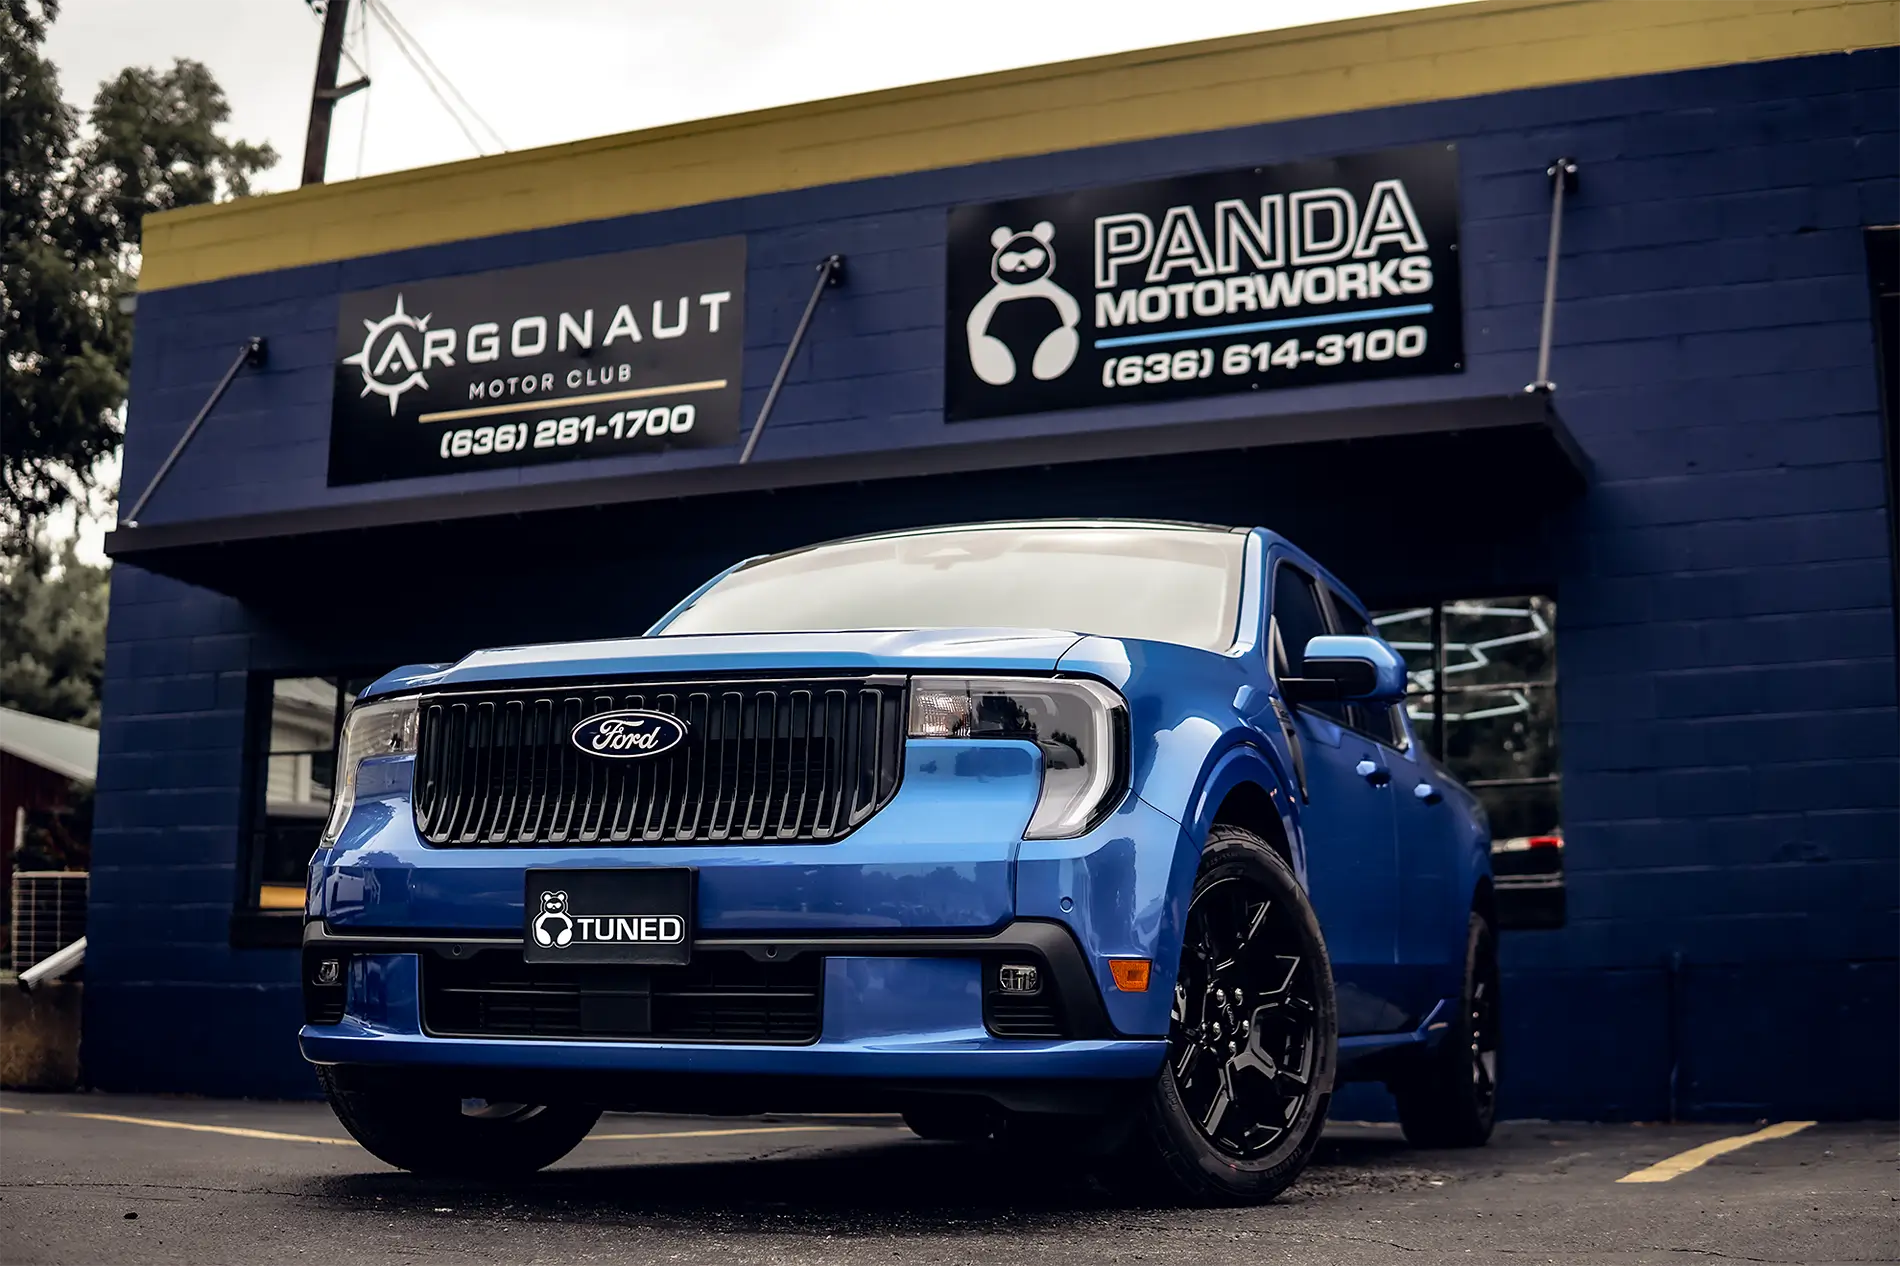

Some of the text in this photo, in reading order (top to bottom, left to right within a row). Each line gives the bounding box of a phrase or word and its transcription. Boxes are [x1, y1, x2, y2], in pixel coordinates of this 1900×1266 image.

[1094, 179, 1428, 287] PANDA
[1095, 256, 1432, 327] MOTORWORKS
[374, 291, 731, 377] ARGONAUT
[1101, 325, 1427, 388] (636) 614-3100
[468, 364, 632, 400] MOTOR CLUB
[439, 404, 695, 459] (636) 281-1700
[591, 718, 661, 750] Ford
[577, 917, 681, 941] TUNED
